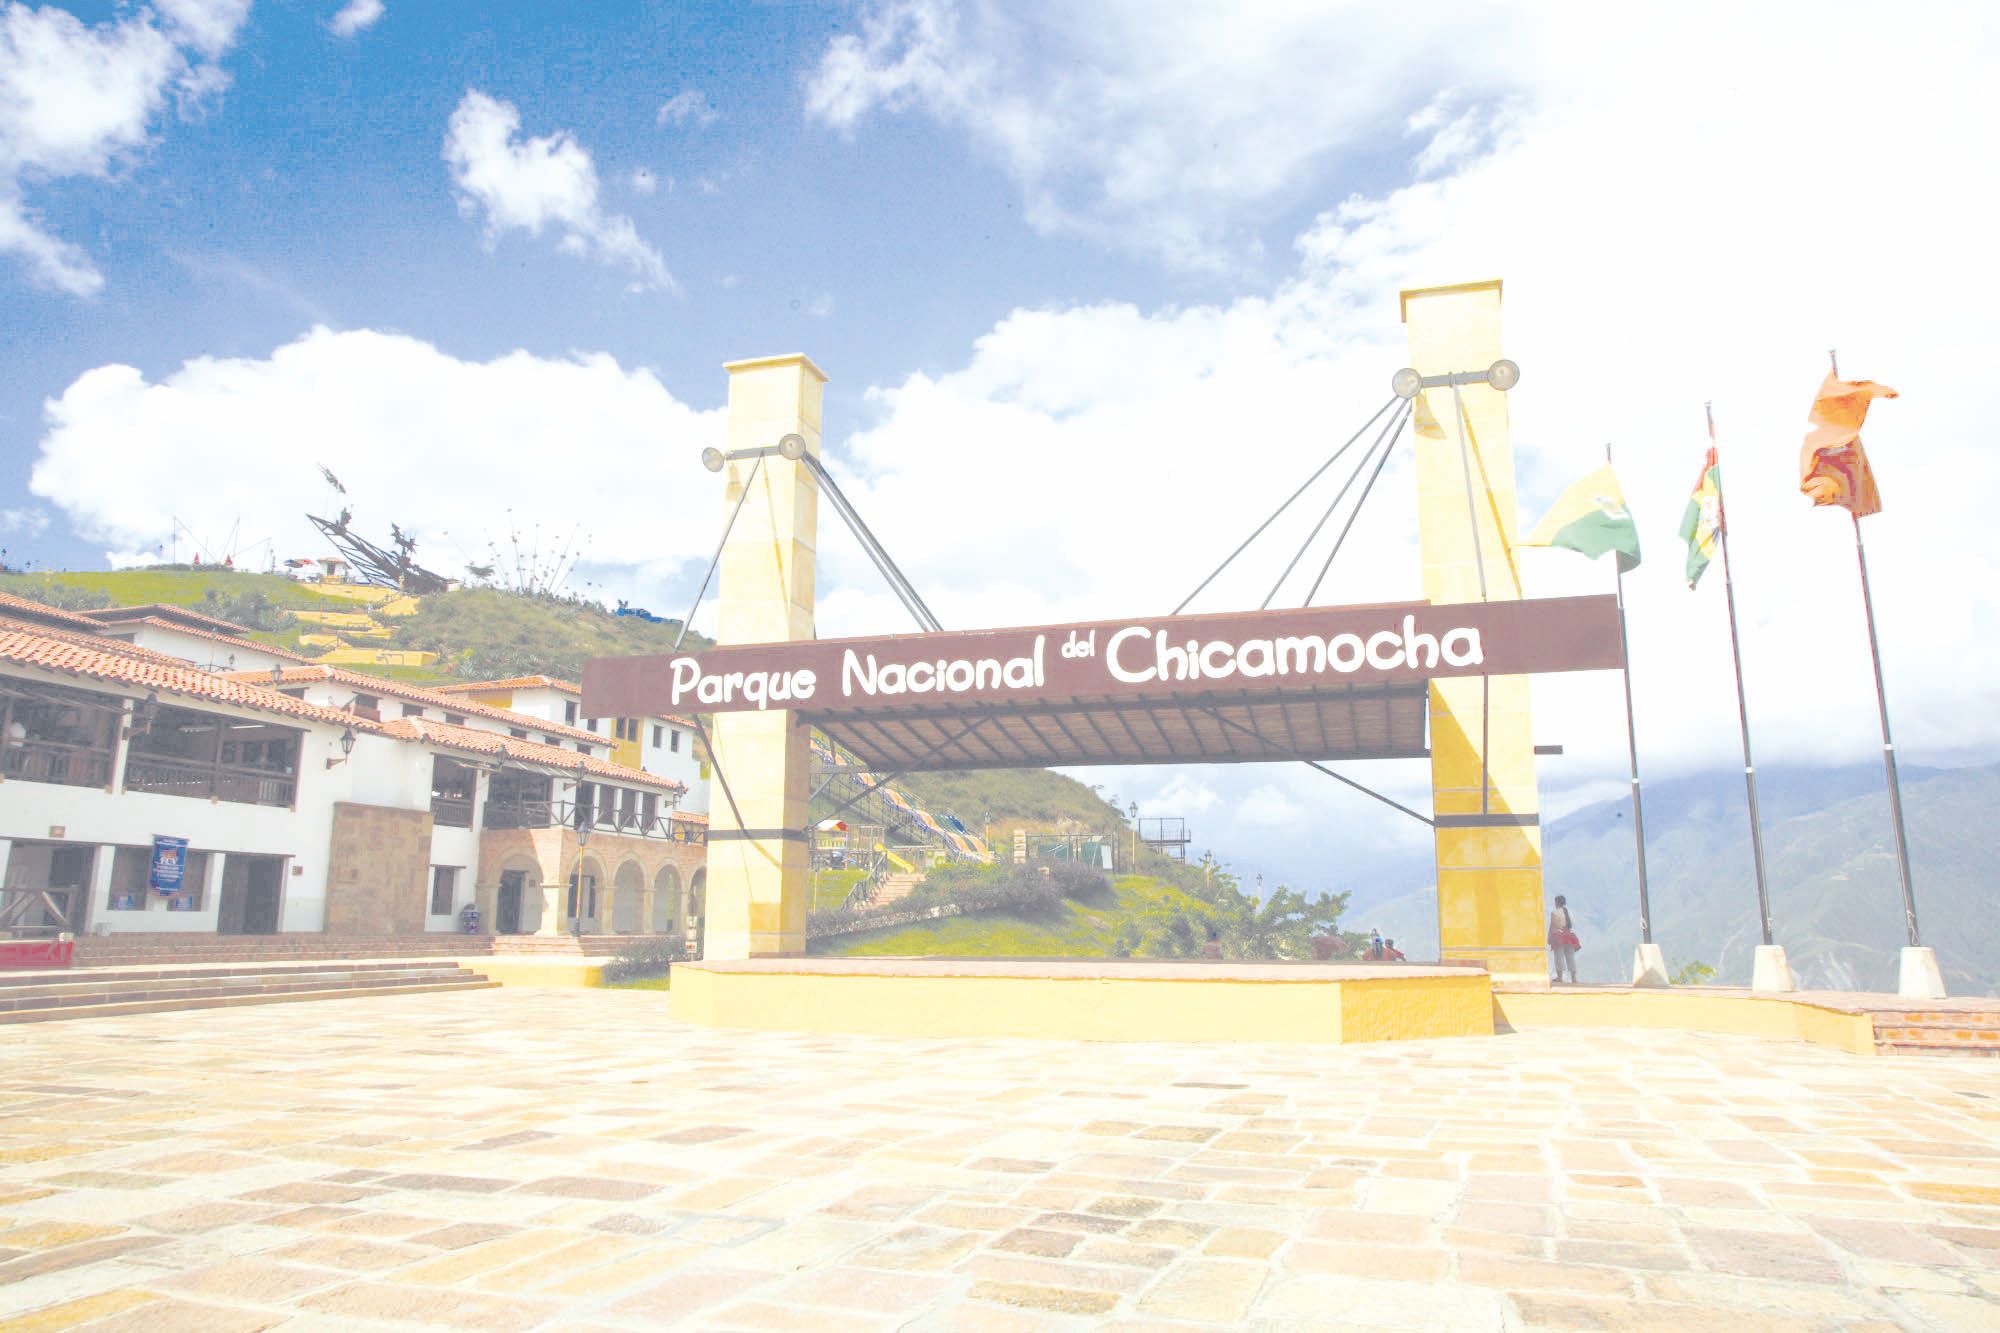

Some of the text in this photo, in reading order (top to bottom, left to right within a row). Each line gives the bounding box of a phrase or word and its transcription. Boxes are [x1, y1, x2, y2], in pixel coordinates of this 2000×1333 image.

[671, 615, 1484, 710] Parque Nacional del Chicamocha
